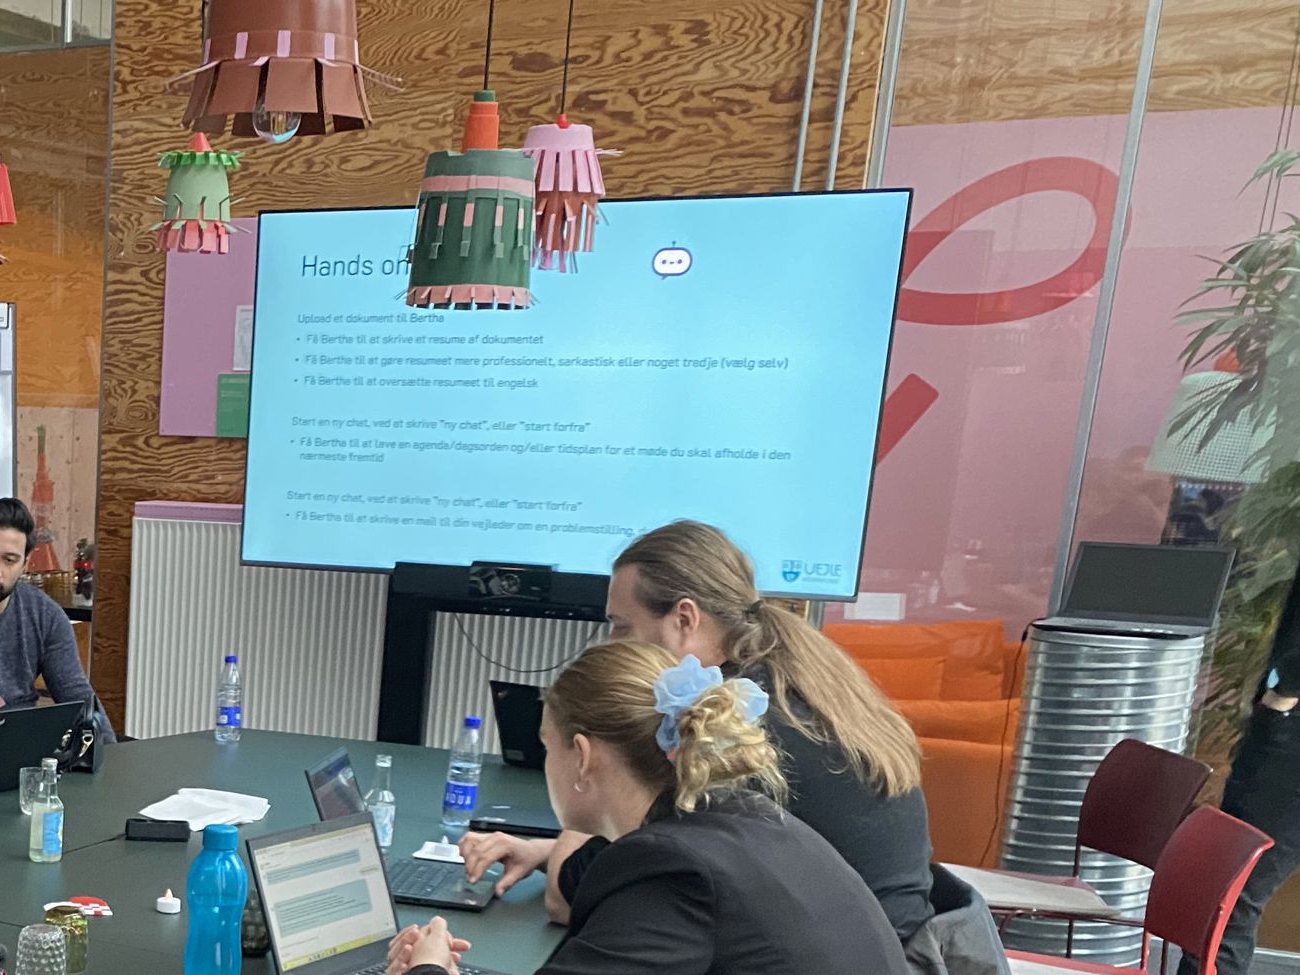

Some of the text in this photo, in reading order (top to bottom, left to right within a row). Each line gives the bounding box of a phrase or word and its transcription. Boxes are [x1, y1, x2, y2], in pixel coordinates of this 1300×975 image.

[301, 254, 374, 277] Hands
[297, 313, 445, 325] Upload et dokument til Bertha
[306, 334, 319, 344] Få
[321, 335, 354, 344] Bertha
[356, 334, 367, 344] til
[370, 336, 381, 344] at
[383, 334, 413, 344] skrive
[415, 335, 426, 344] et
[468, 334, 480, 344] af
[482, 334, 544, 345] dokumentet
[305, 355, 789, 370] Få Bertha til at gøre resumeet mere professionelt, sarkastisk eller noget tredje (vælg selv)
[304, 376, 539, 391] Få Bertha til at oversætte resumeet til engelsk
[291, 417, 316, 427] Start
[332, 420, 345, 429] ny
[347, 418, 371, 429] chat,
[373, 419, 391, 429] ved
[393, 419, 403, 428] at
[406, 419, 437, 429] skrive
[492, 421, 517, 431] eller
[300, 437, 312, 447] Få
[314, 437, 347, 447] Bertha
[349, 438, 360, 448] til
[362, 439, 373, 448] at
[375, 438, 397, 449] lave
[399, 441, 411, 449] en
[413, 440, 509, 453] agenda/dagsorden
[511, 443, 555, 455] og/eller
[557, 443, 602, 455] tidsplan
[604, 444, 620, 455] for
[623, 446, 635, 455] et
[637, 446, 668, 457] møde
[670, 447, 684, 458] du
[686, 447, 712, 458] skal
[714, 448, 759, 460] afholde
[768, 449, 791, 461] den
[299, 453, 385, 463] nærmeste fremtid
[286, 491, 312, 501] Start
[313, 494, 325, 502] en
[327, 494, 340, 504] ny
[341, 493, 365, 503] chat,
[367, 494, 386, 503] ved
[387, 495, 398, 504] at
[400, 495, 431, 505] skrive
[485, 498, 511, 509] eller
[295, 511, 308, 521] Få
[310, 511, 342, 522] Bertha
[344, 512, 355, 523] til
[356, 514, 367, 523] at
[369, 513, 400, 525] skrive
[401, 516, 414, 525] en
[416, 516, 437, 527] mail
[439, 517, 451, 527] til
[453, 517, 470, 528] din
[472, 518, 515, 532] vejleder
[517, 522, 533, 531] om
[535, 523, 549, 532] en
